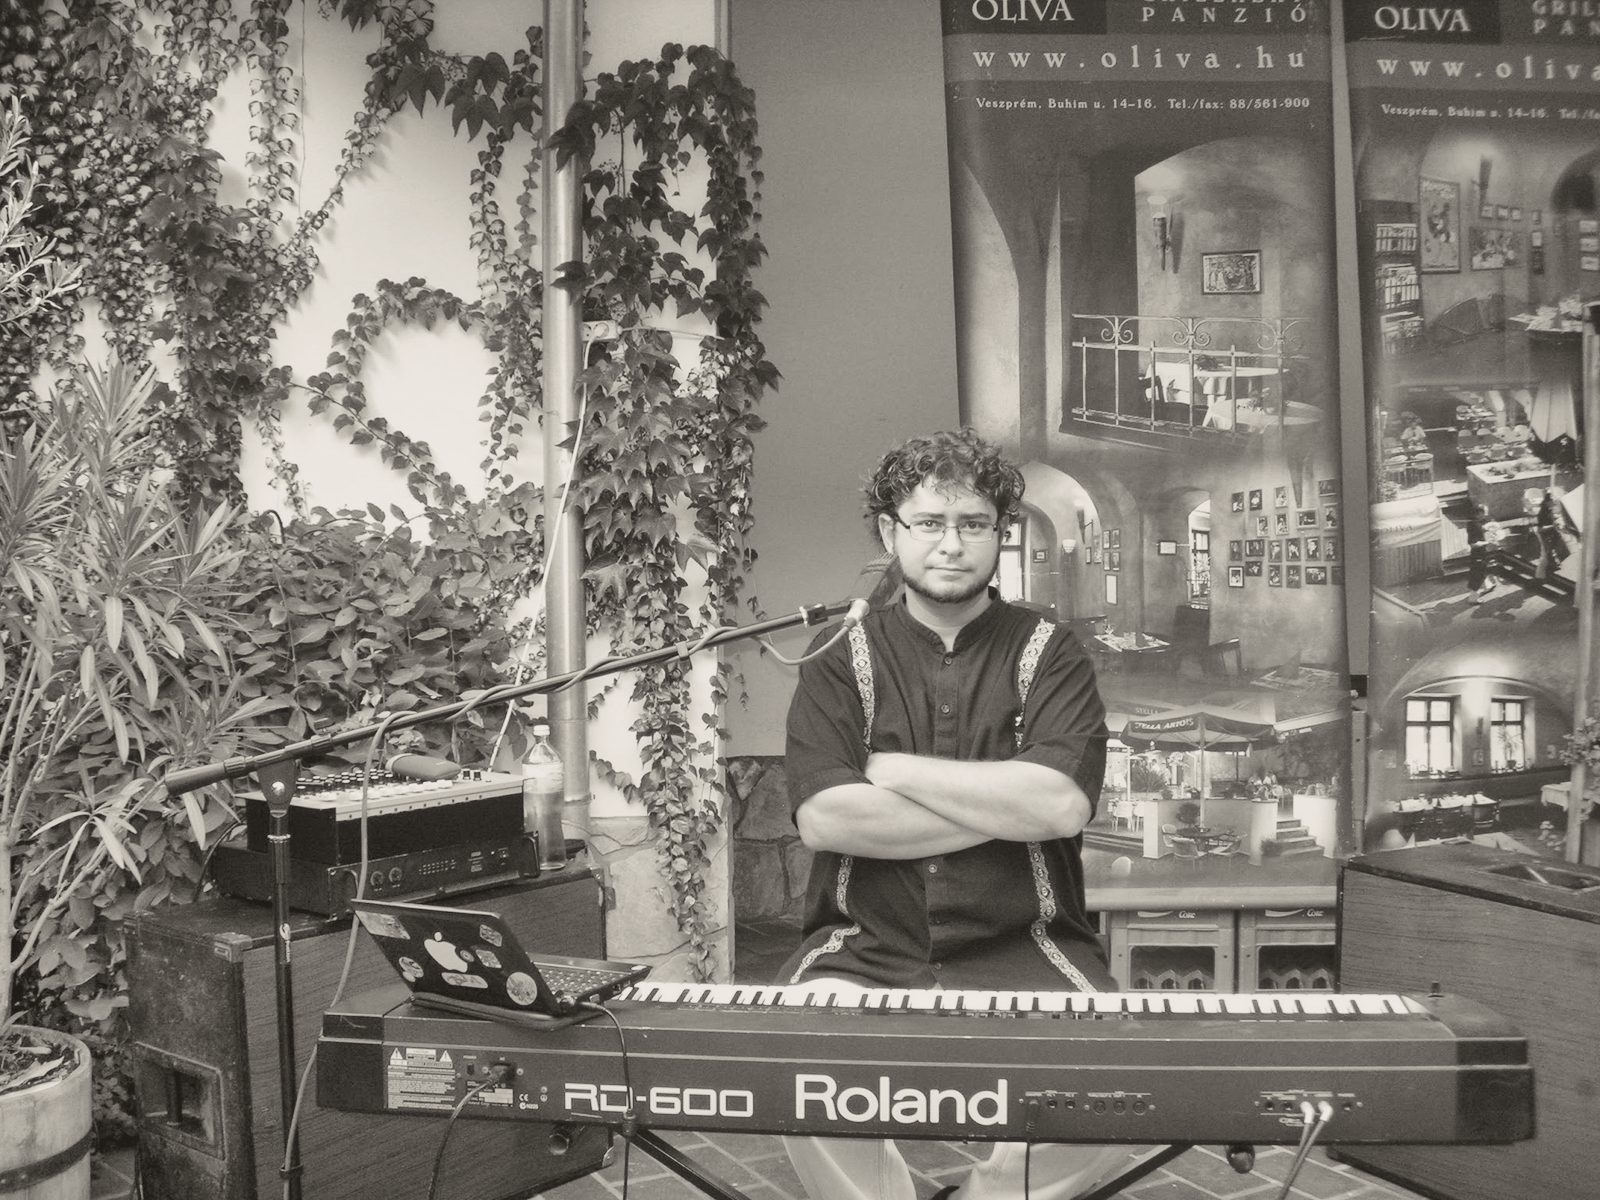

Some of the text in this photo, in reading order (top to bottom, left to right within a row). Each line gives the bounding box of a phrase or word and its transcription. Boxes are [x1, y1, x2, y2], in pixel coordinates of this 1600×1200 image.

[971, 0, 1075, 24] OLIVA
[1141, 4, 1306, 23] PANZIÓ
[1374, 6, 1471, 32] OLIVA
[1532, 0, 1600, 16] GRIL
[973, 45, 1305, 69] www.oliva.hu
[1093, 100, 1105, 109] u.
[1229, 97, 1310, 110] 88/561-900
[795, 1073, 1008, 1126] Roland
